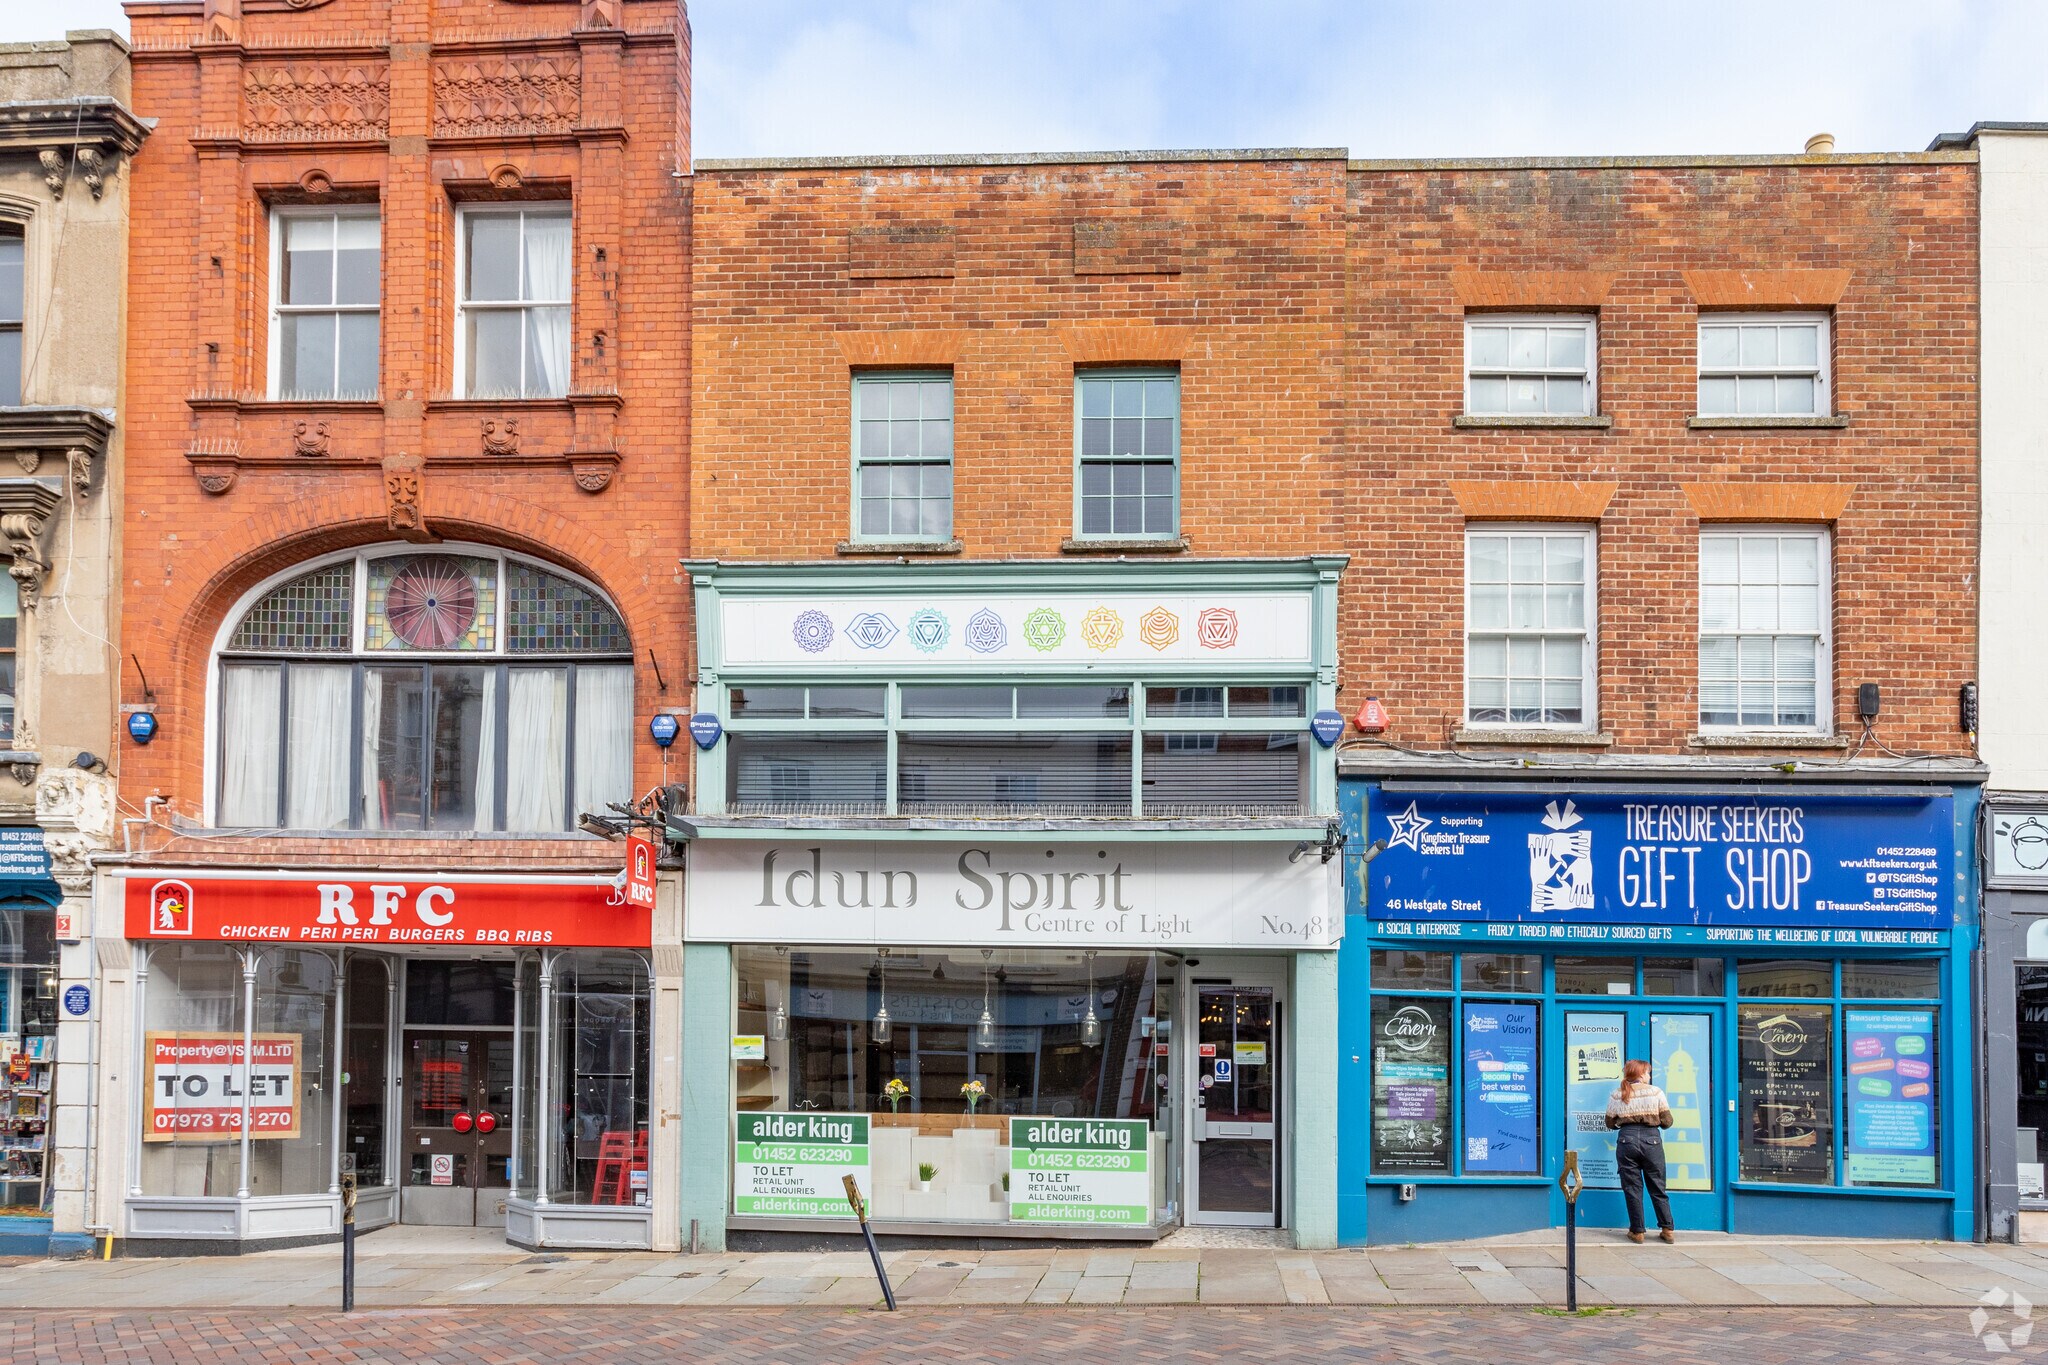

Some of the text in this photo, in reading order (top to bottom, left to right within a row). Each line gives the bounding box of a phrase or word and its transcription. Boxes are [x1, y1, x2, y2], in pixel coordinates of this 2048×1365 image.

[1440, 816, 1483, 829] Supporting
[1623, 804, 1804, 844] TREASURE SEEKERS
[2, 832, 19, 842] 01452
[1420, 832, 1490, 846] Kingfisher Treasure
[1420, 844, 1464, 855] Seekers Ltd
[1877, 847, 1937, 857] 01452 228489
[1840, 858, 1938, 872] www.kftseekers.org.uk
[1619, 846, 1811, 911] GIFT SHOP
[1878, 872, 1938, 886] @TSGiftShop
[631, 881, 653, 904] RFC
[755, 848, 1135, 932] Idun Spirit
[1886, 888, 1938, 901] TSGiftShop
[316, 884, 455, 928] RFC
[1386, 899, 1482, 913] 46 Westgate Street
[1826, 900, 1938, 915] TreasureSeekersGiftShop
[220, 925, 553, 943] CHICKEN PERI PERI BURGERS BBQ RIBS
[1024, 914, 1193, 941] Centre of Light
[1260, 915, 1323, 942] No.48
[1378, 923, 1938, 944] A SOCIAL ENTERPRISE FAIRLY TRADED AND ETHICALLY SOURCED GIFTS SUPPORTING THE WELLBEING OF LOCAL VULNERABLE PEOPLE
[1506, 1013, 1526, 1023] Our
[1849, 1014, 1928, 1024] Treasure Seekers Hub
[1384, 1017, 1437, 1037] Cavern
[1502, 1024, 1532, 1035] Vision
[1571, 1025, 1620, 1034] Welcome to
[1759, 1028, 1810, 1045] Cavern
[1585, 1046, 1618, 1060] LIGHTHOUSE
[1503, 1063, 1529, 1073] people
[1512, 1072, 1525, 1081] the
[158, 1074, 290, 1098] TO LET
[1481, 1082, 1498, 1091] best
[1500, 1083, 1526, 1092] version
[1479, 1093, 1528, 1103] of themselves
[155, 1113, 214, 1129] 07973
[258, 1112, 291, 1127] 270
[752, 1115, 853, 1144] alder king
[1027, 1121, 1131, 1150] alder king
[1497, 1129, 1532, 1143] Find out more
[752, 1147, 852, 1163] 01452 623290
[1027, 1153, 1131, 1169] 01452 623290
[752, 1166, 794, 1177] TO LET
[1028, 1172, 1071, 1183] TO LET
[752, 1177, 804, 1186] RETAIL UNIT
[1028, 1184, 1081, 1193] RETAIL UNIT
[752, 1186, 816, 1196] ALL ENQUIRIES
[1028, 1193, 1093, 1203] ALL ENQUIRIES
[752, 1197, 852, 1214] alderking.com
[1028, 1204, 1131, 1221] alderking.com
